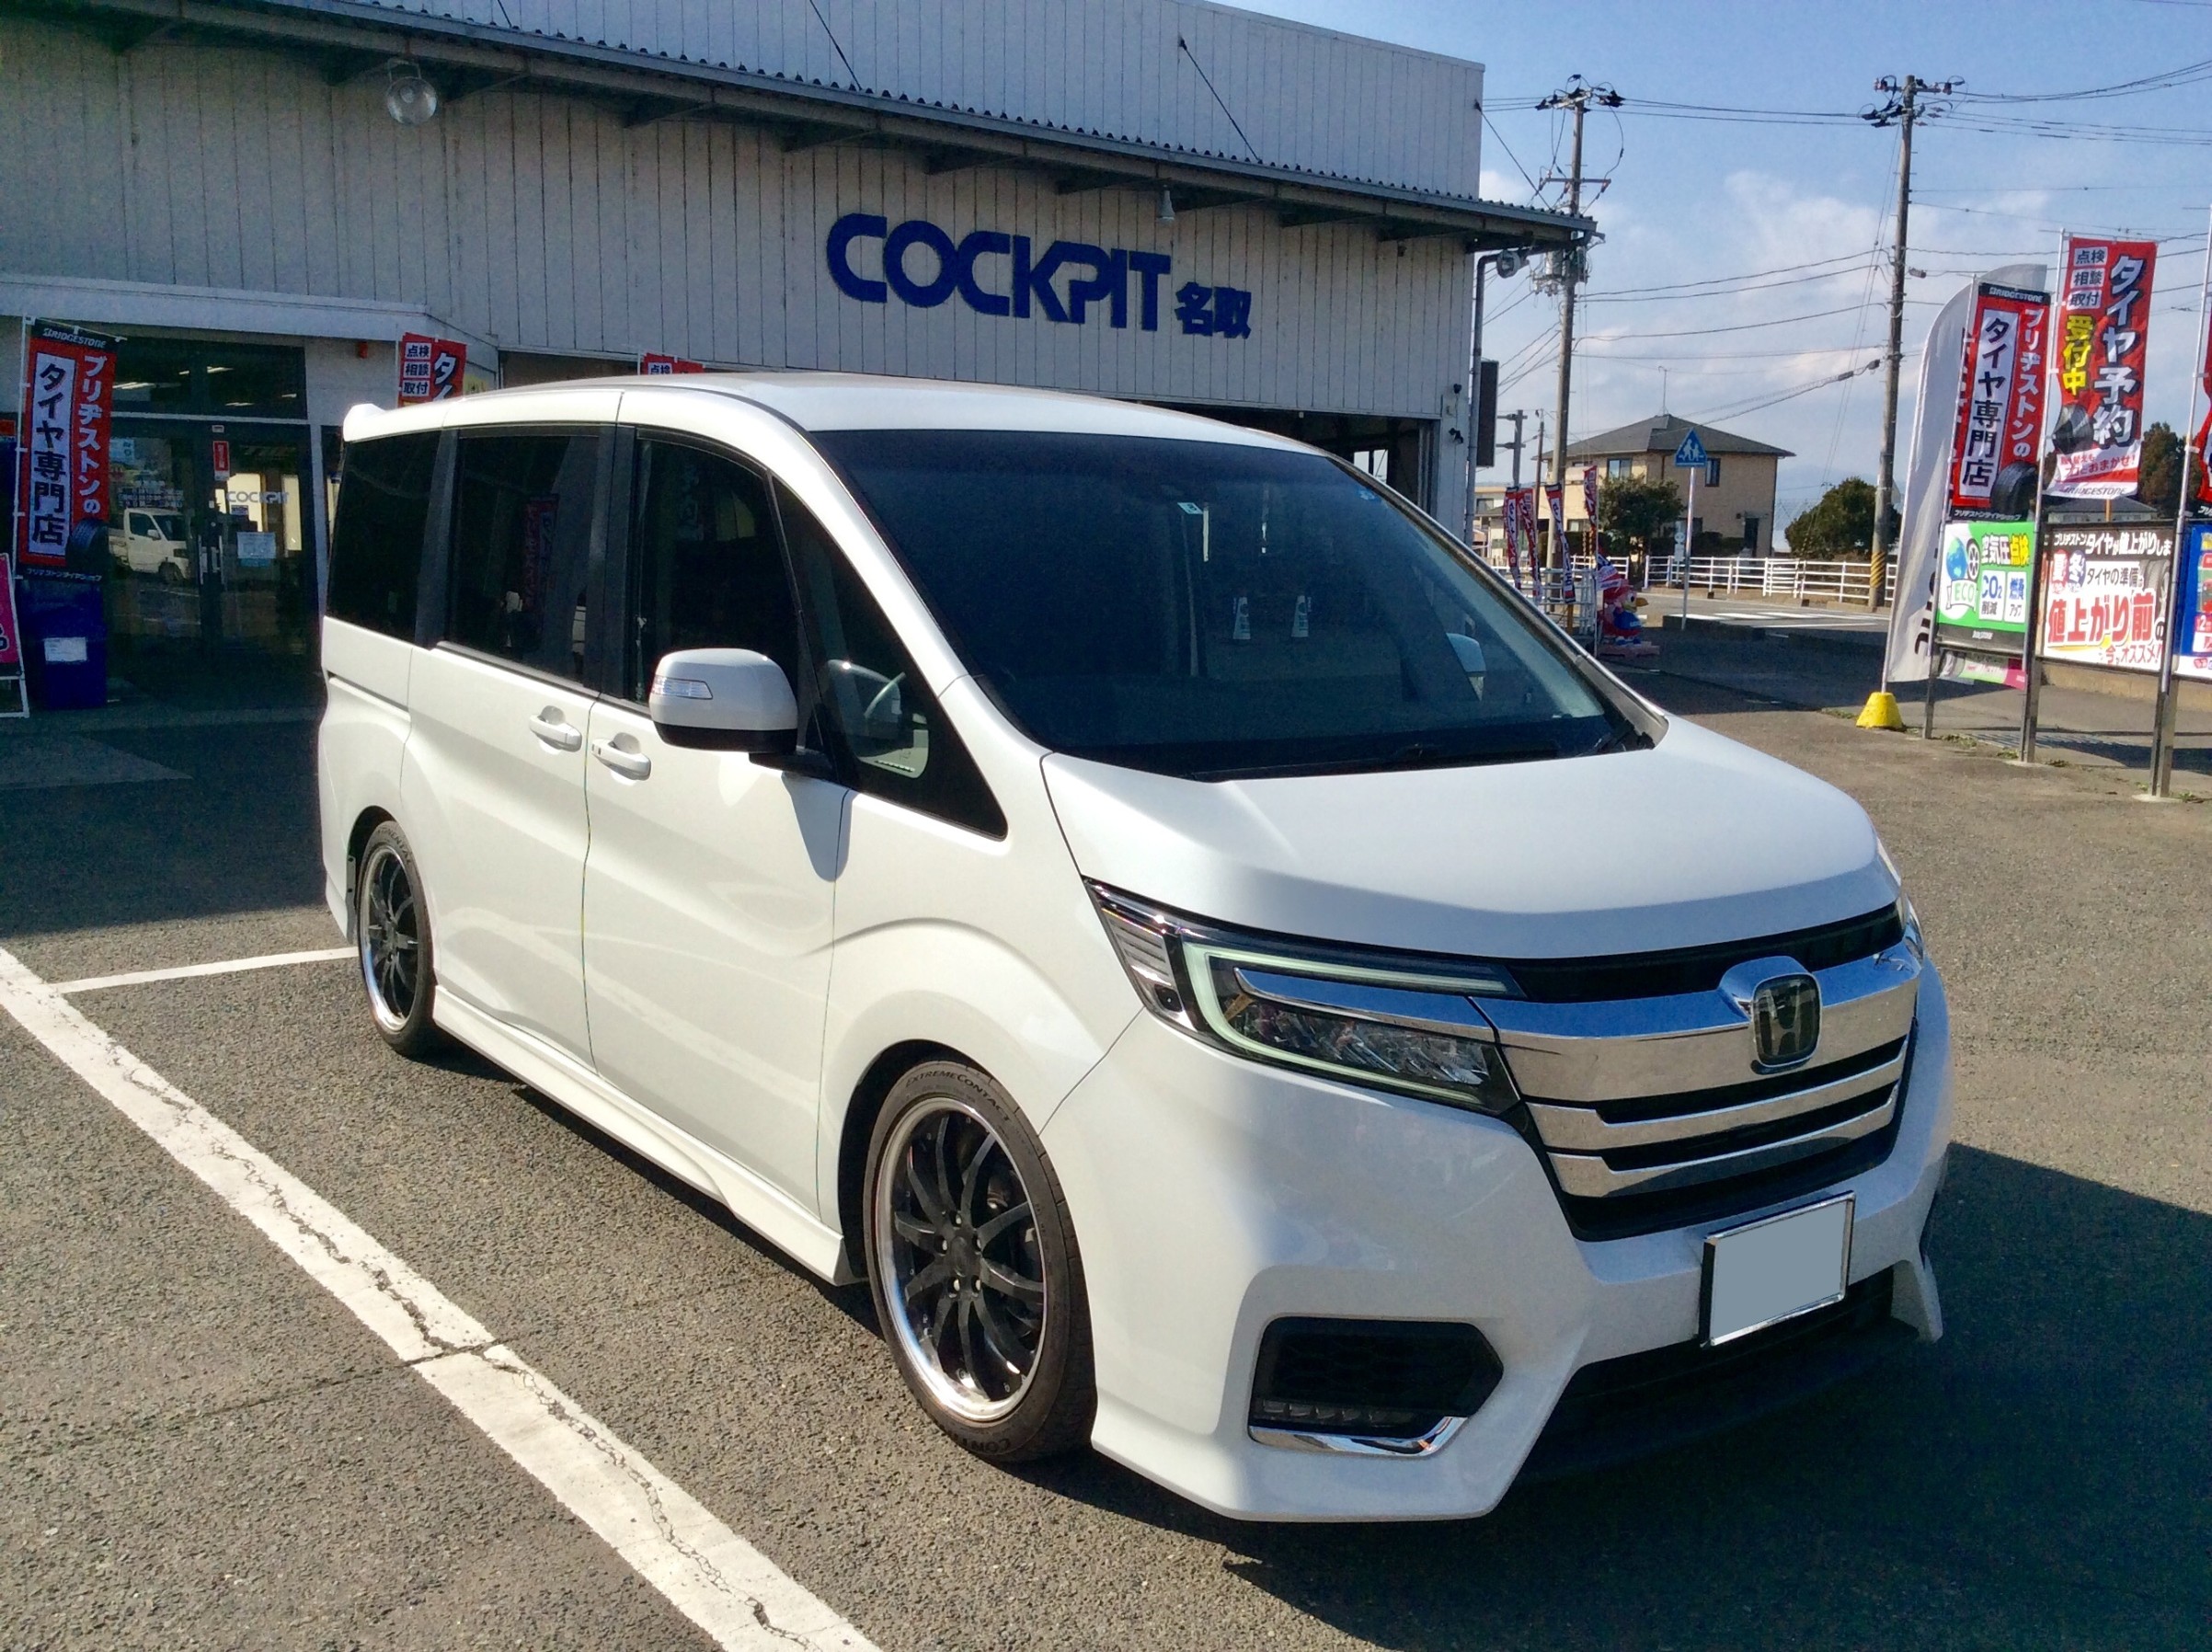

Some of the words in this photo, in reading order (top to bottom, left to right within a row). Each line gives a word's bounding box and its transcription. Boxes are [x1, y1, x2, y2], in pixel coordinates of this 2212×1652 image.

[2076, 249, 2105, 264] 点検
[827, 212, 1171, 331] COCKPIT
[1175, 281, 1252, 339] 名取
[2074, 270, 2103, 285] 相談
[1989, 287, 2043, 303] BRIDGESTONE
[2069, 292, 2100, 306] 取付
[42, 327, 107, 348] BRIDGESTONE
[407, 345, 430, 358] 点検
[2063, 315, 2093, 396] 受付中
[2093, 256, 2144, 445] タイヤ予約
[405, 363, 429, 376] 相談
[404, 382, 428, 395] 取付
[1962, 317, 2010, 487] タイヤ専門店
[32, 363, 66, 545] タイヤ専門店
[1981, 533, 2029, 567] 空気圧点検
[1954, 582, 1975, 602] ECO
